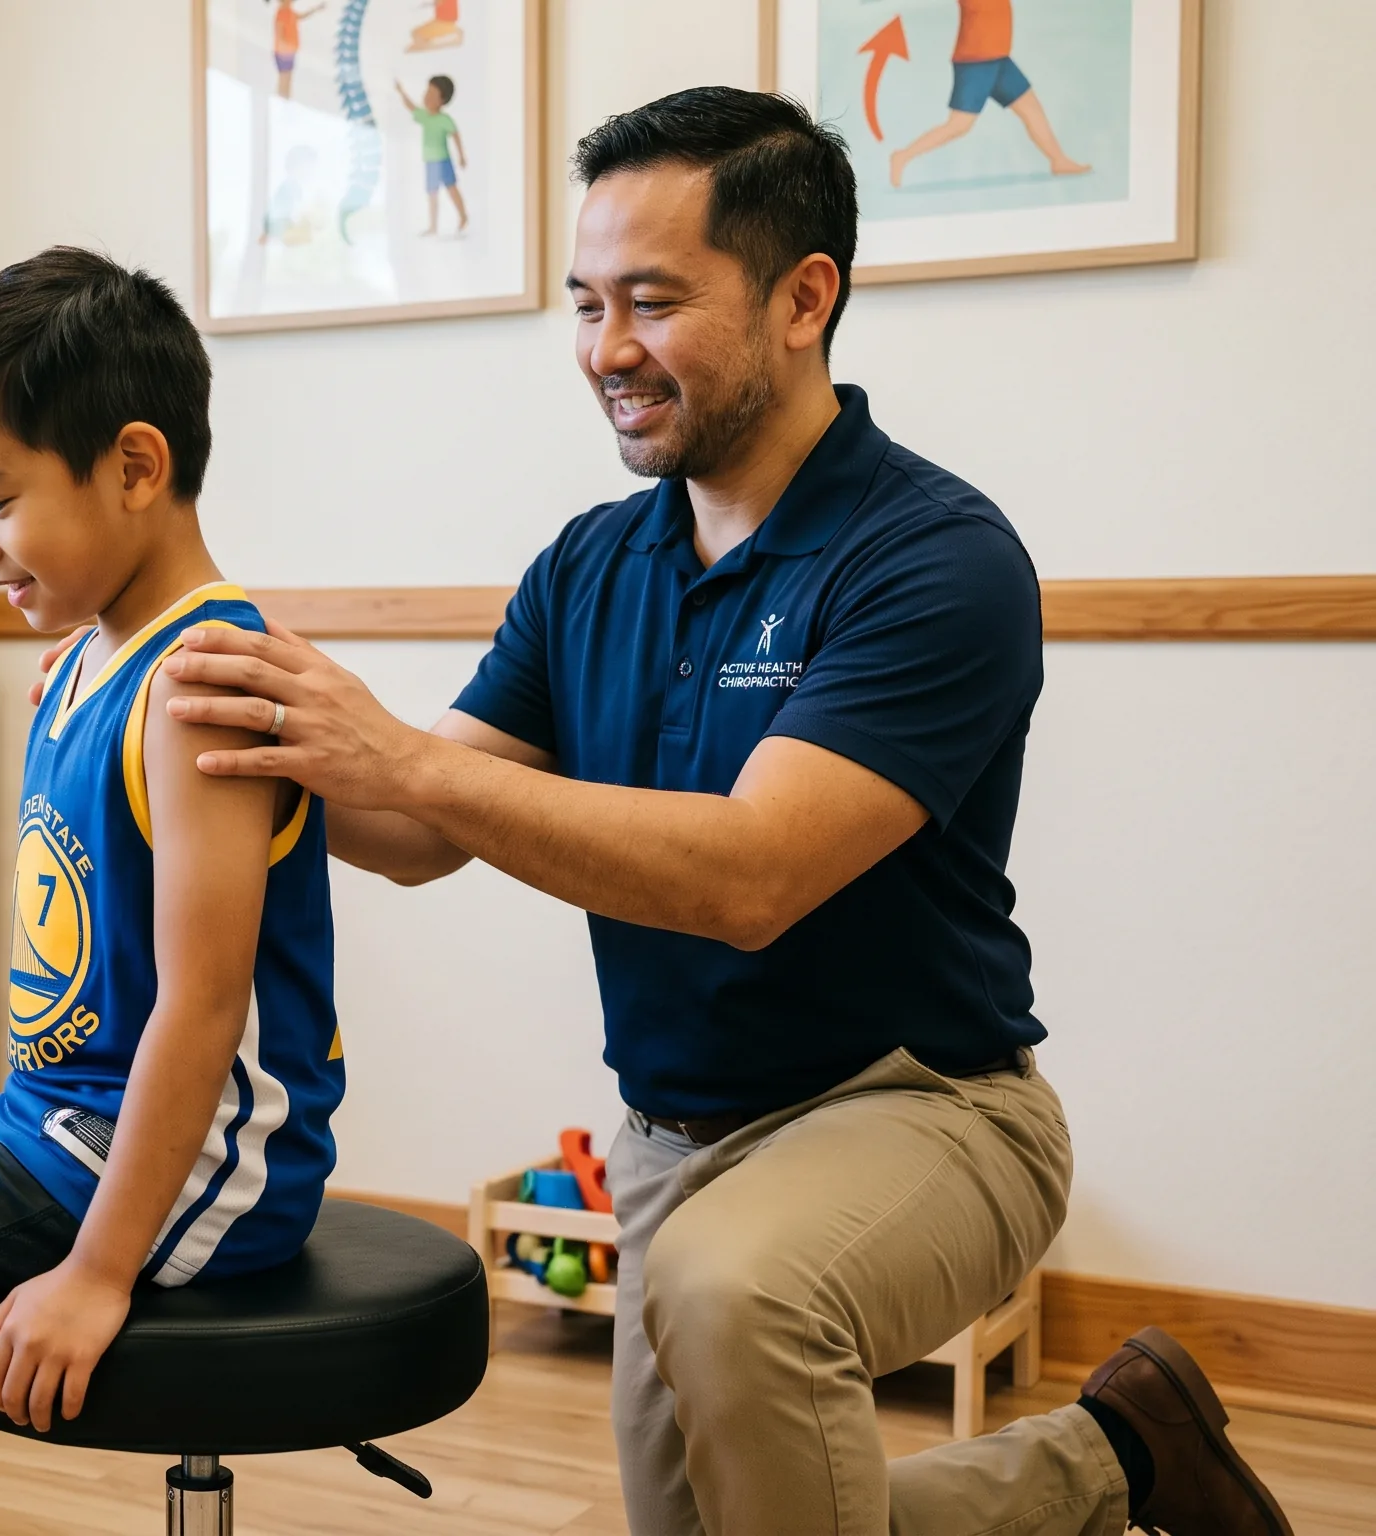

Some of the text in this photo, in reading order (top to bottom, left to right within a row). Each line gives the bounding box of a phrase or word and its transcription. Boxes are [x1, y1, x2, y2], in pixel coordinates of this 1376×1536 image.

[718, 676, 799, 688] CHIROPRACTIC
[719, 662, 802, 673] ACTIVE HEALTH
[44, 802, 94, 878] STATE
[38, 873, 57, 927] 7
[8, 1005, 100, 1072] RRIORS
